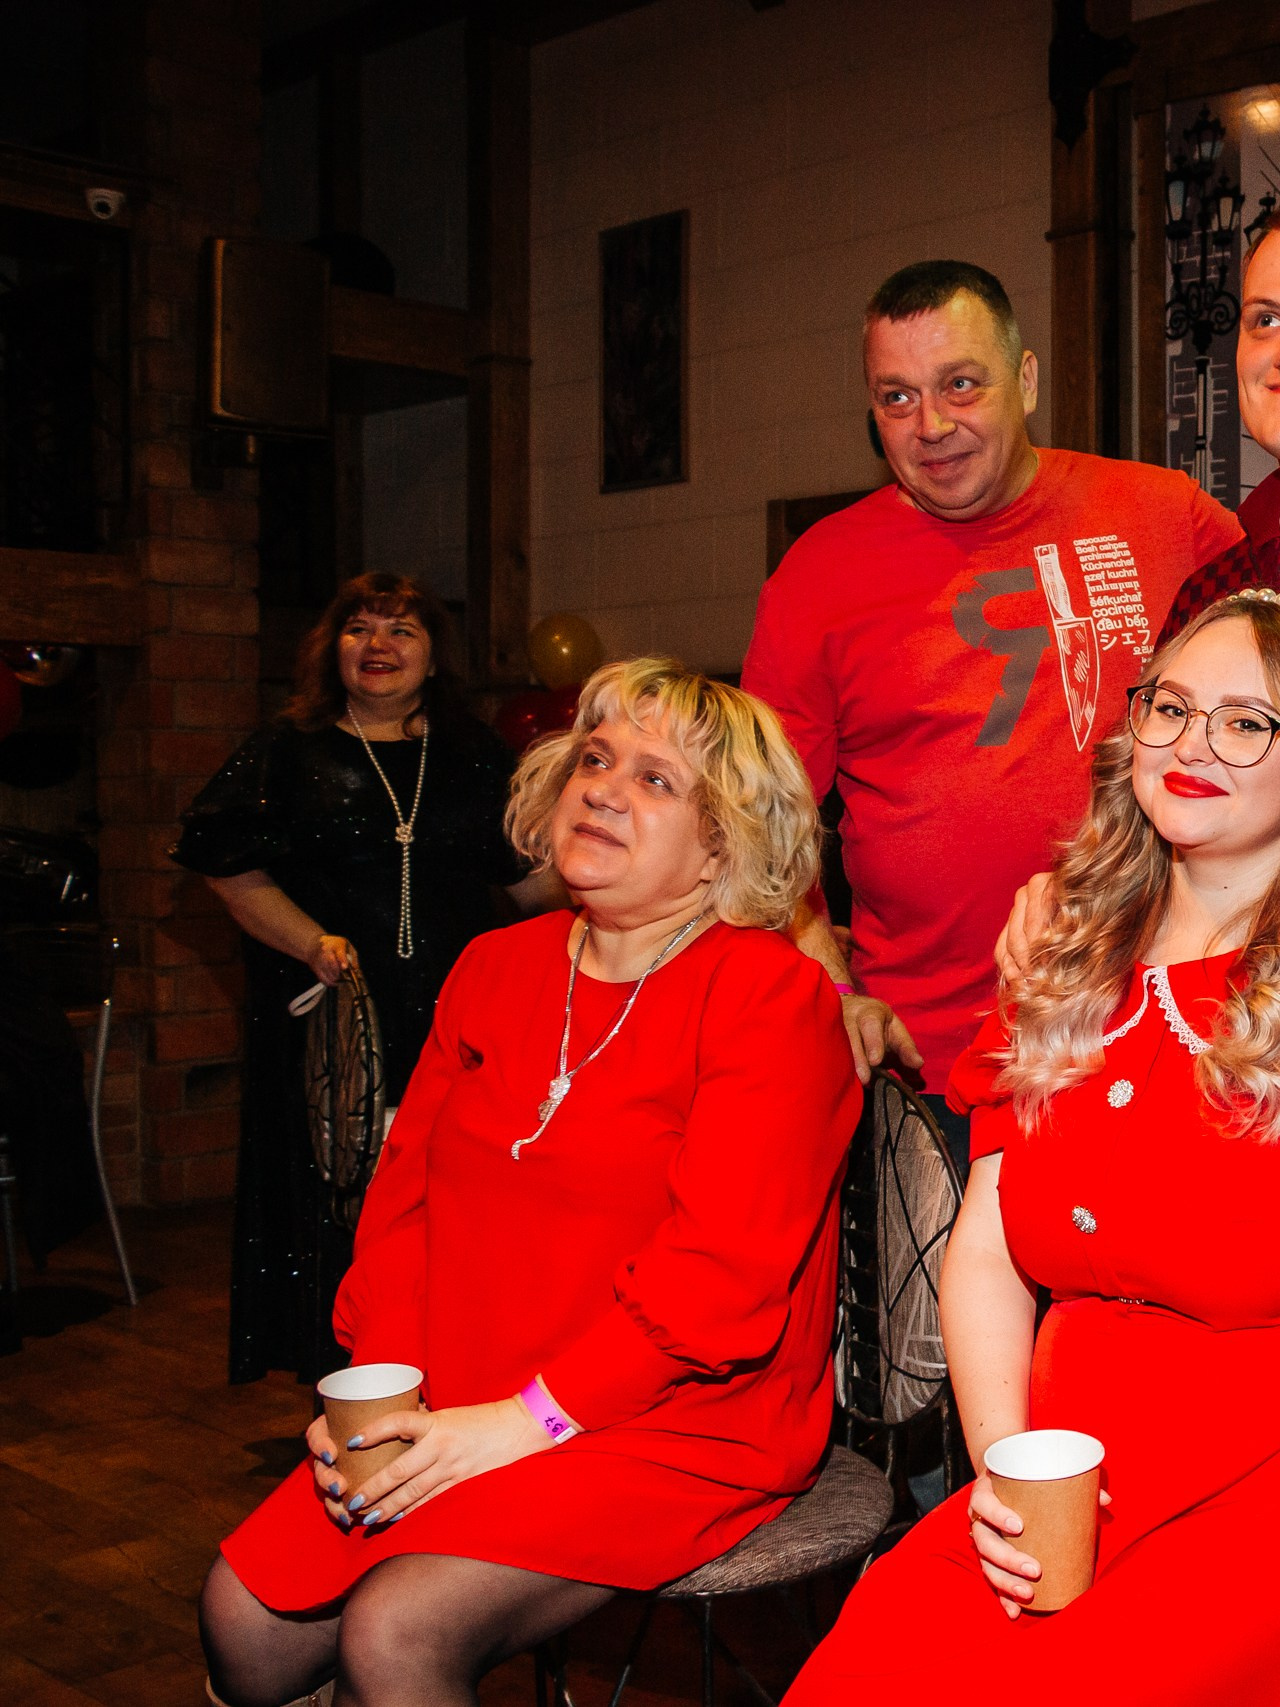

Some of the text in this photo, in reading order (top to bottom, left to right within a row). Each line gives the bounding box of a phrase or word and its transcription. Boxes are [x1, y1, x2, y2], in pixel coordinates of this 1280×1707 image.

[1073, 534, 1118, 546] capocuoco
[1080, 557, 1135, 572] Küchenchef
[1084, 567, 1139, 582] szef kuchni
[1092, 604, 1145, 618] cocinero
